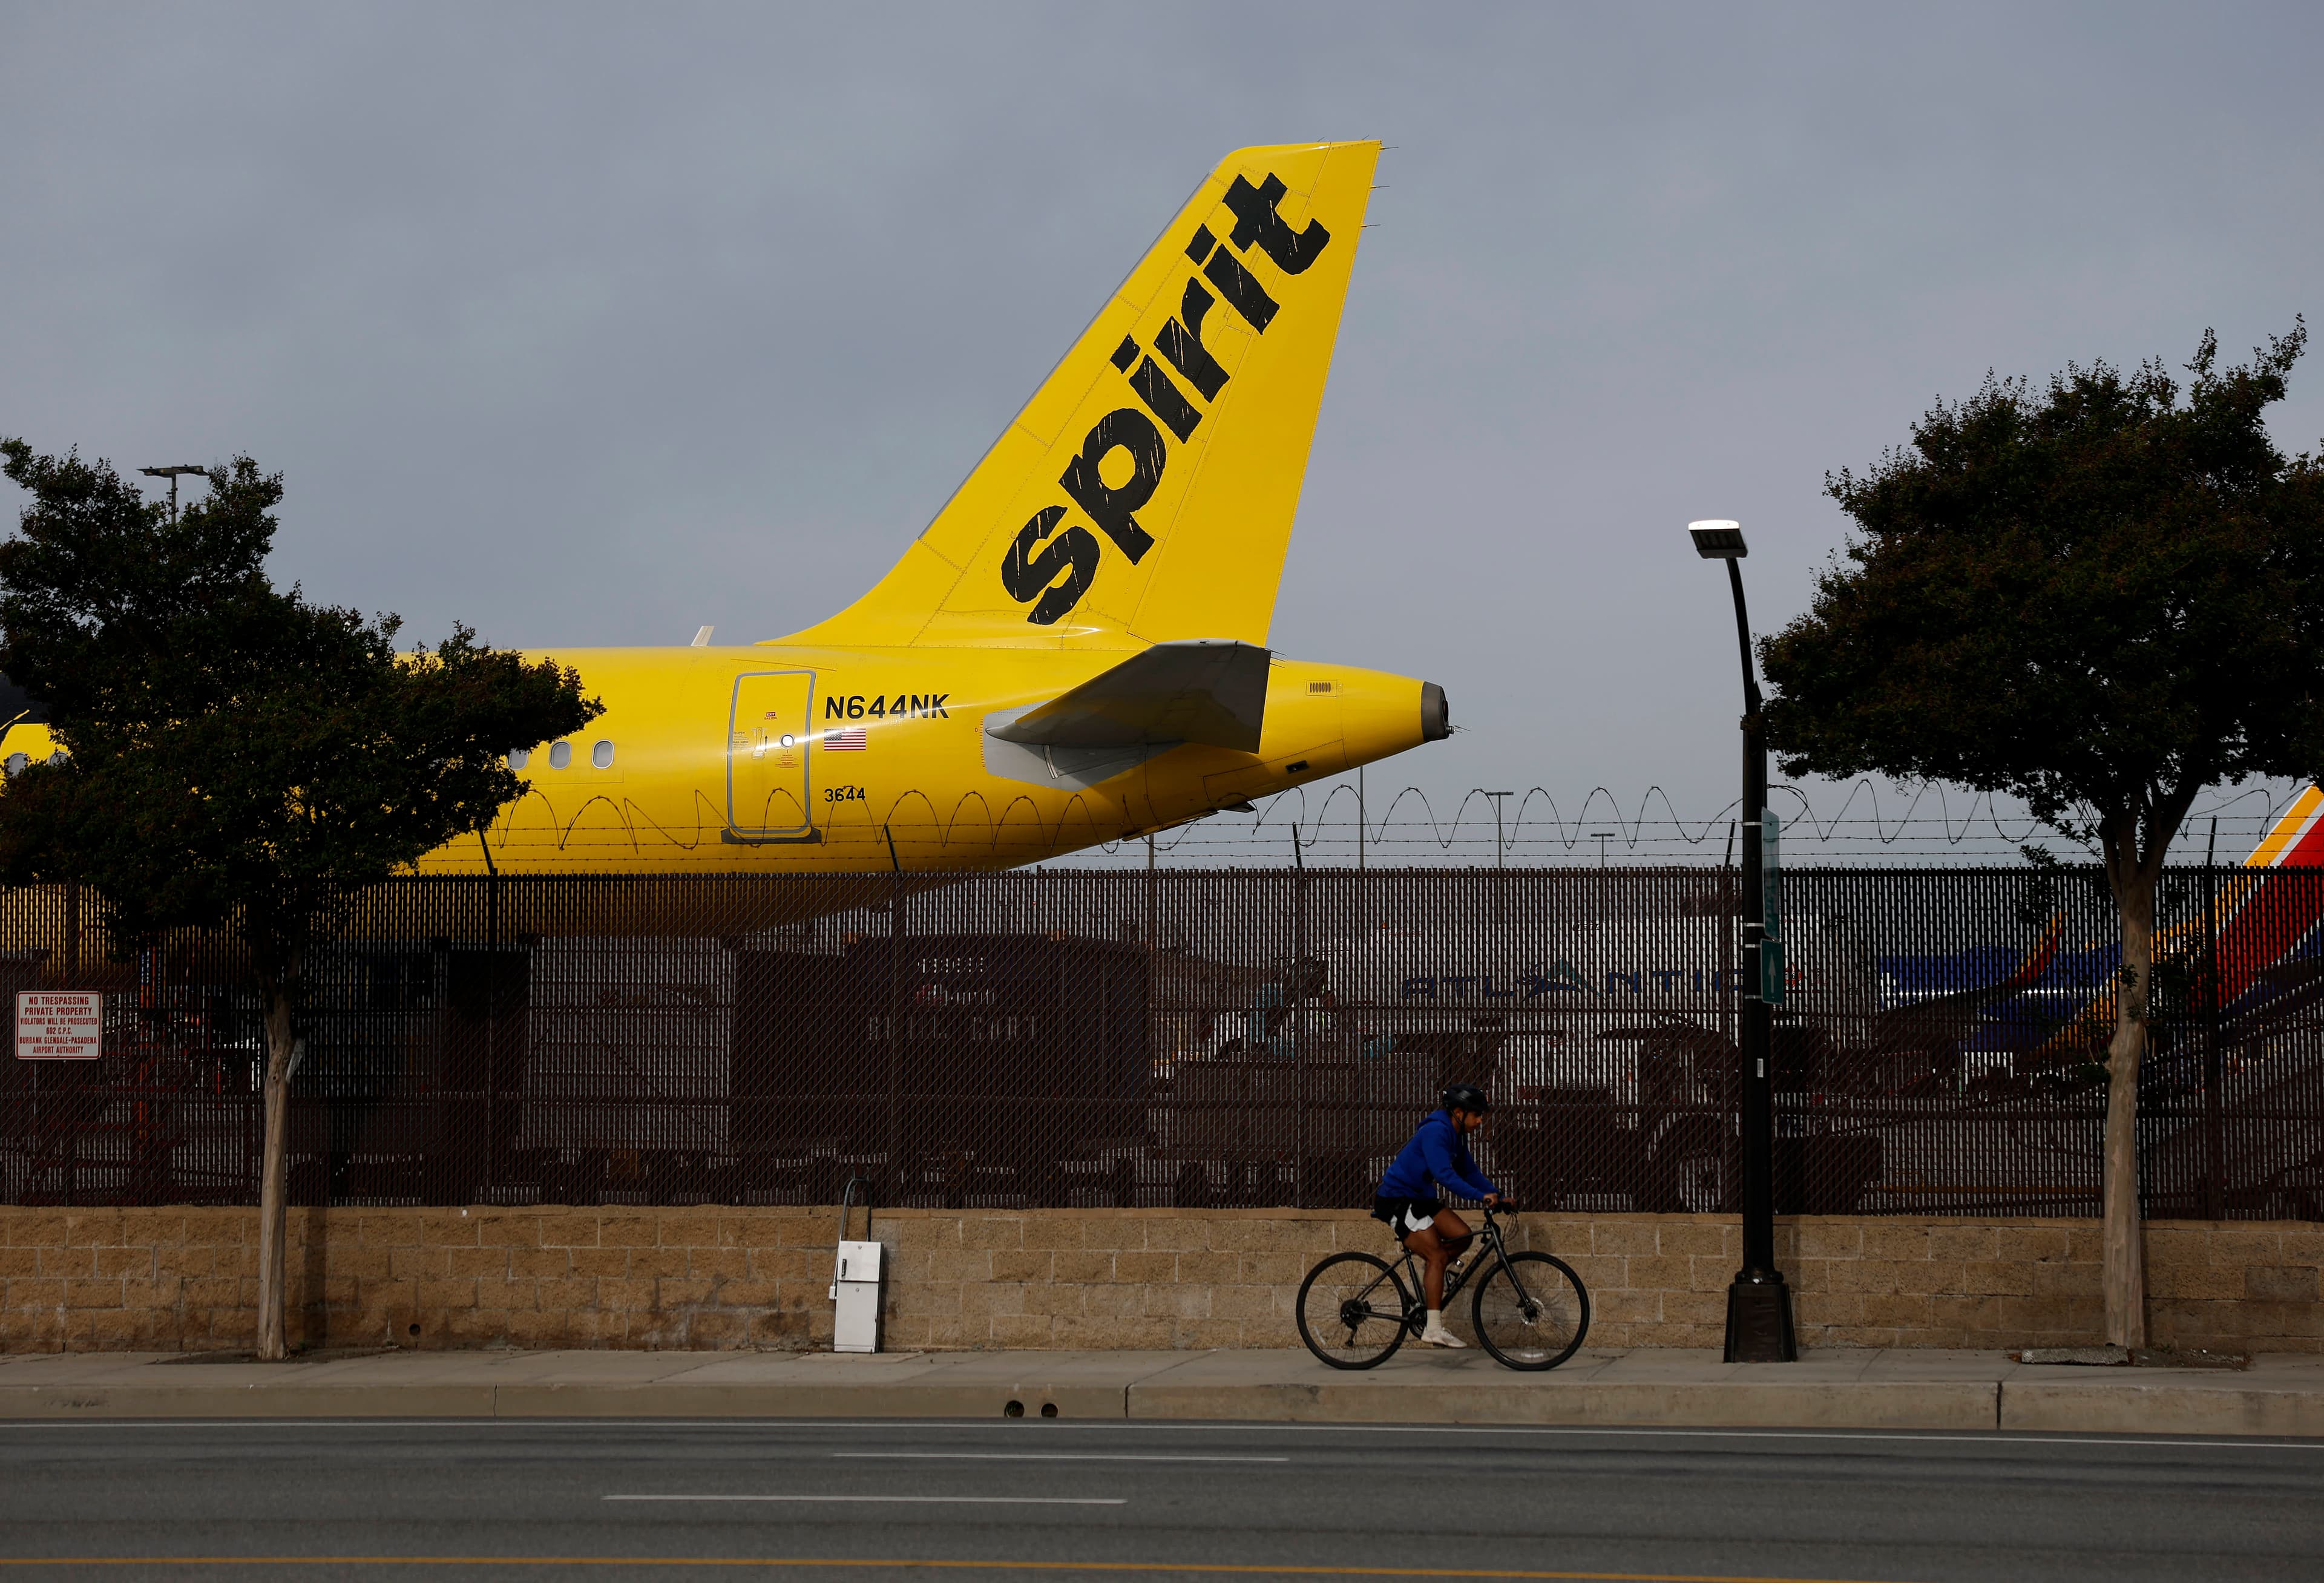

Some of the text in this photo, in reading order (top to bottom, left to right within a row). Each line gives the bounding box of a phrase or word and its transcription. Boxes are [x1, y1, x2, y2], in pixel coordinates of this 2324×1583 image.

[1001, 172, 1331, 626] spirit
[825, 693, 950, 719] N644NK
[824, 787, 866, 802] 3644
[28, 997, 89, 1005] NO TRESPASSING
[25, 1007, 92, 1015] PRIVATE PROPERTY
